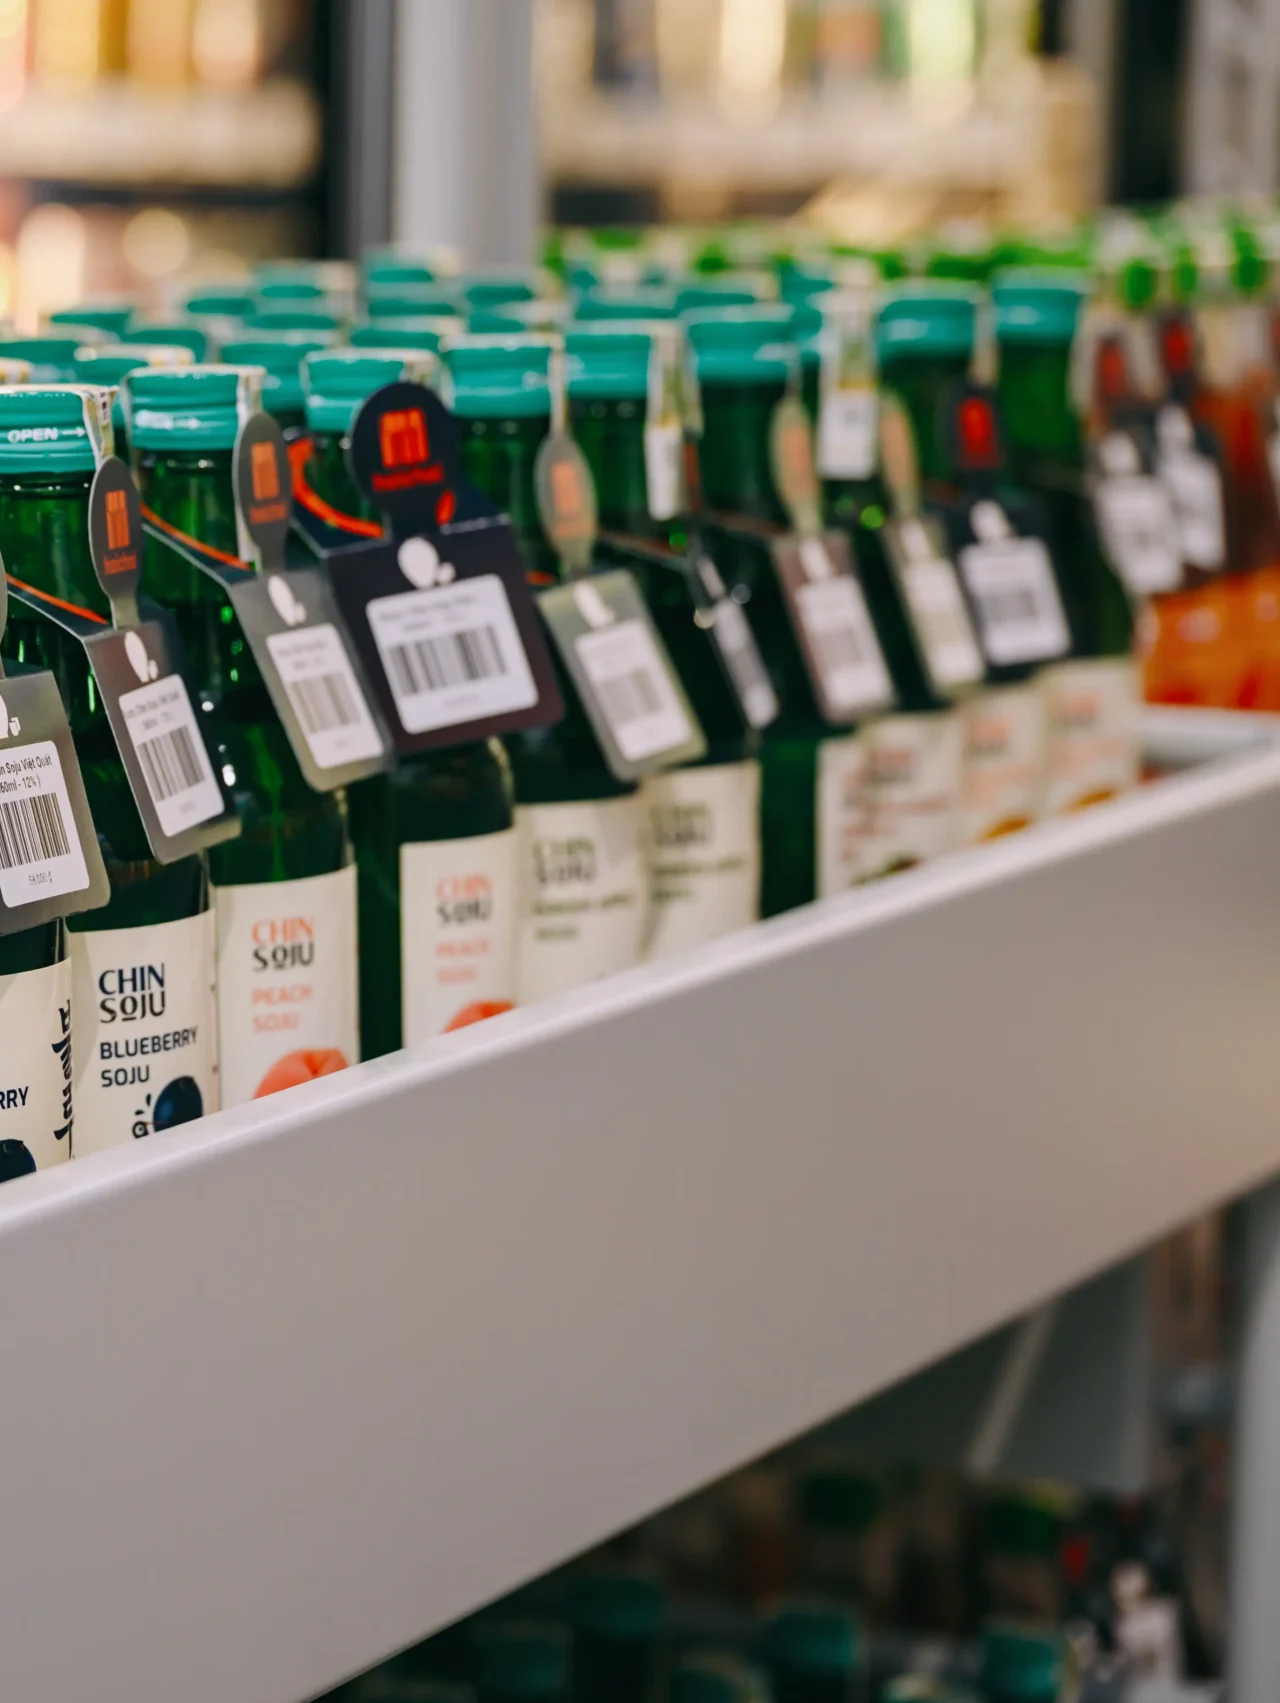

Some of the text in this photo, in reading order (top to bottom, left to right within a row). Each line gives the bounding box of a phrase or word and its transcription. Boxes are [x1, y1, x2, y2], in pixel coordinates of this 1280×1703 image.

[7, 427, 59, 443] OPEN
[6, 760, 22, 776] Soju
[252, 941, 314, 972] SOJU
[99, 963, 165, 995] CHIN
[100, 990, 166, 1023] SOJU
[100, 1026, 198, 1060] BLUEBERRY
[101, 1065, 150, 1087] SOJU
